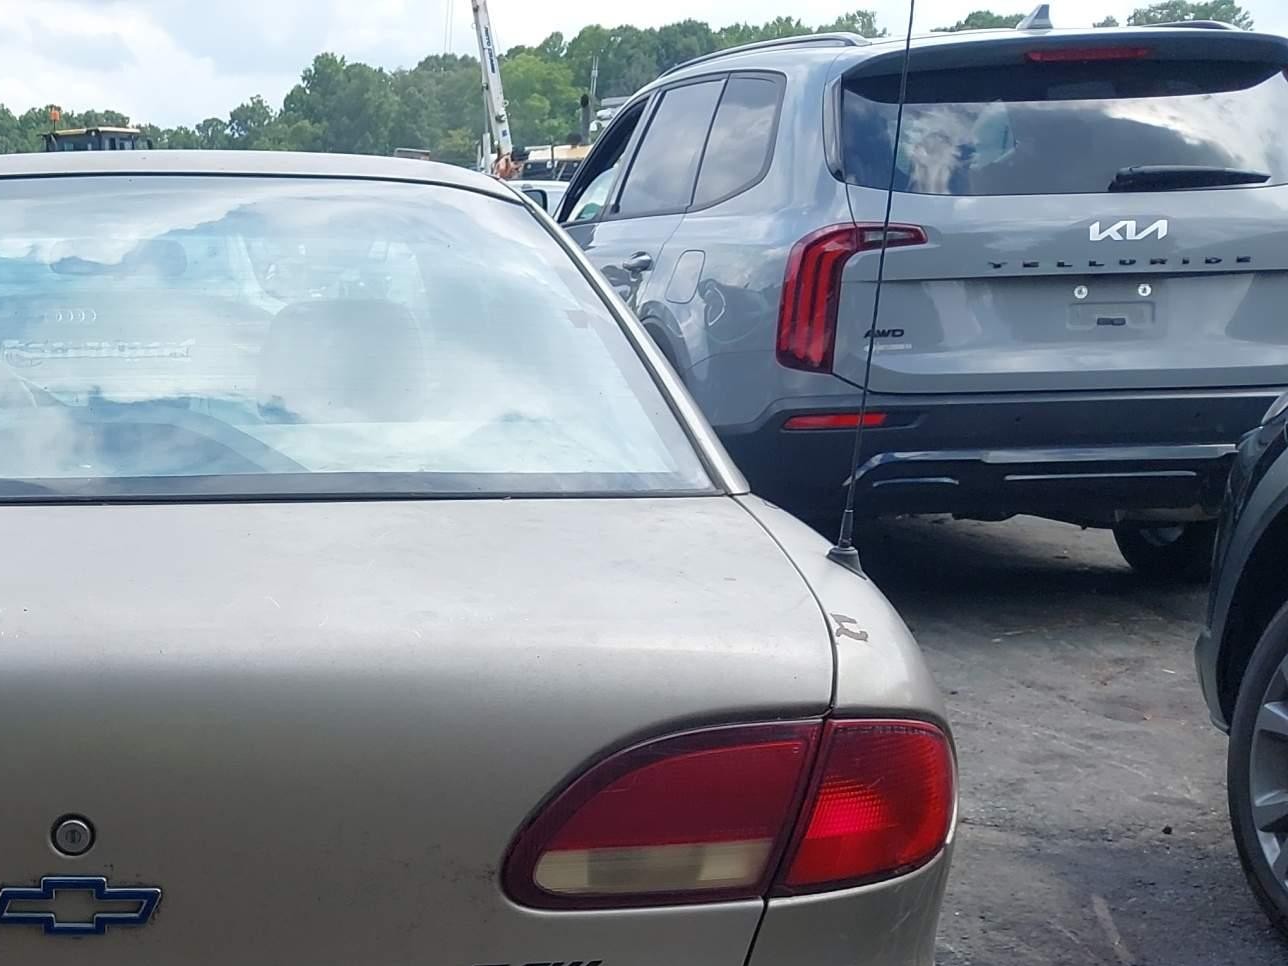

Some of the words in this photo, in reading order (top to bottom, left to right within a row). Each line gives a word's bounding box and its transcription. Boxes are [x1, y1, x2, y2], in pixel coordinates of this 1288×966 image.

[1089, 219, 1168, 241] KIA
[988, 255, 1251, 269] TELLURIDE
[864, 329, 904, 338] AWD
